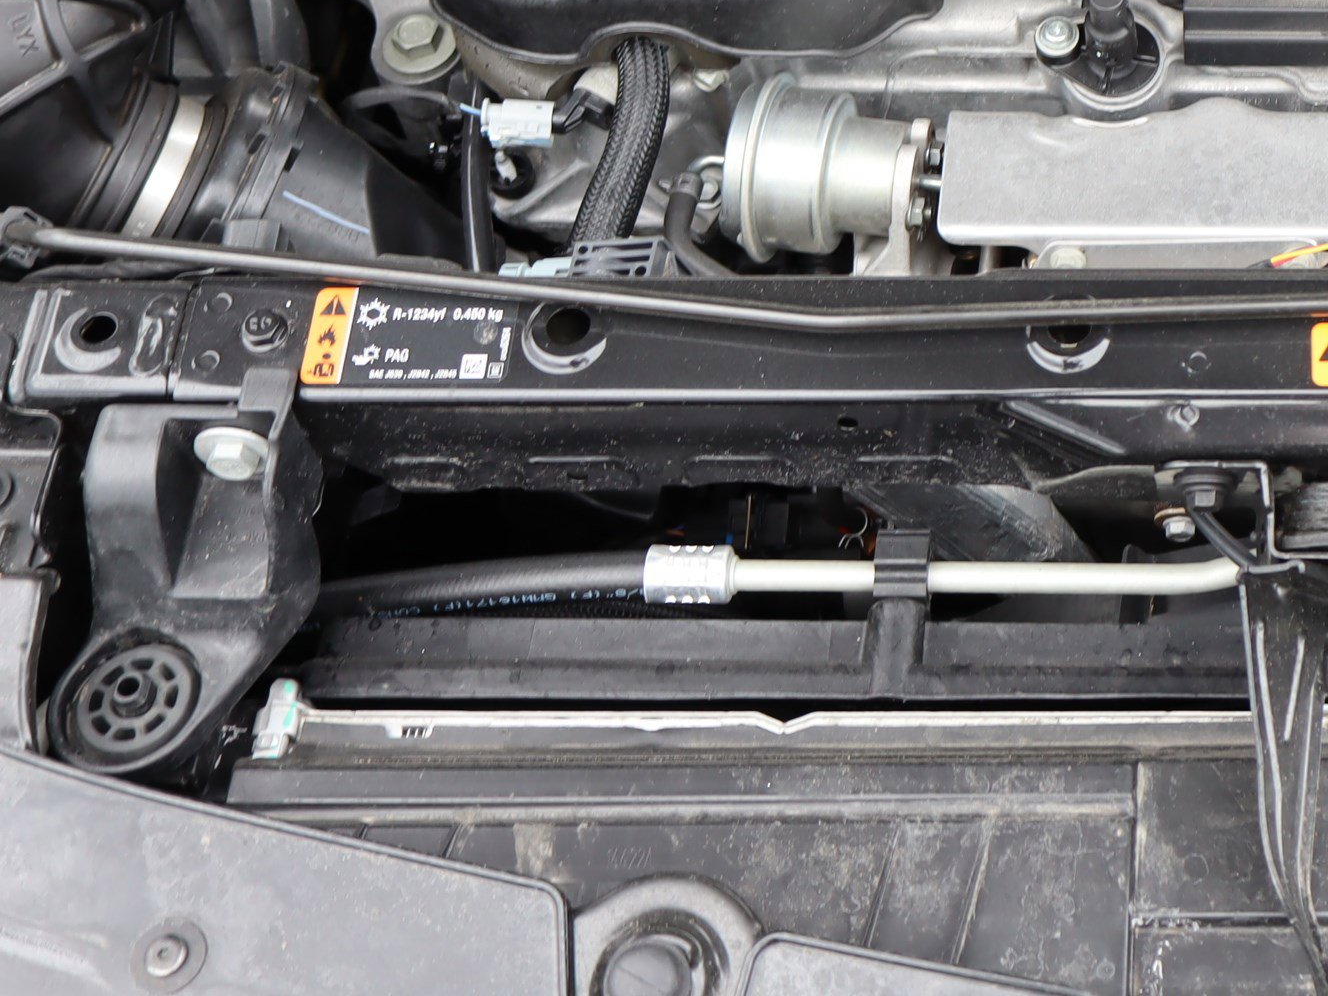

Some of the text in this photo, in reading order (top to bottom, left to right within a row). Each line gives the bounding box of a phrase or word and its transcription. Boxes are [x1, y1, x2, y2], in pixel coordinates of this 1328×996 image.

[392, 307, 446, 323] R-1234yf
[487, 307, 504, 323] kg
[384, 349, 410, 363] PAG
